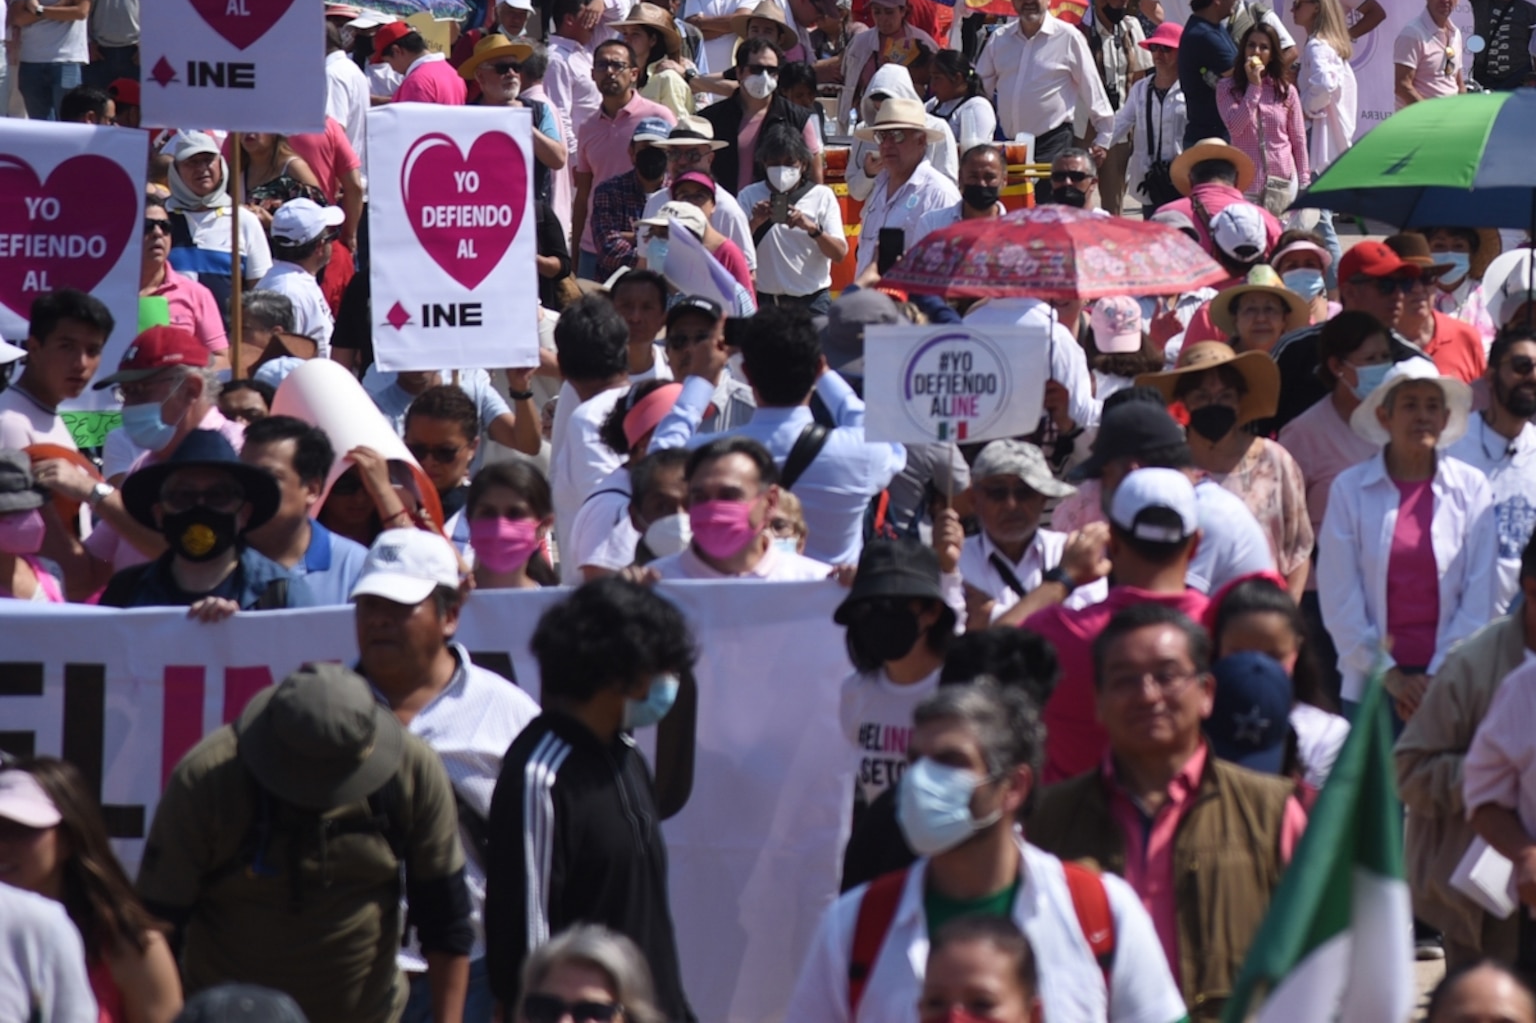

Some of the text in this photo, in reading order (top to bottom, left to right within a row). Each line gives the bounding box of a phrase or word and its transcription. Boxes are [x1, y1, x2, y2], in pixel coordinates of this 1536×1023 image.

[187, 60, 256, 89] INE
[453, 171, 480, 193] YO
[25, 196, 61, 220] YO
[421, 205, 513, 228] DEFIENDO
[457, 239, 478, 259] AL
[22, 270, 53, 292] AL
[422, 302, 483, 328] INE
[938, 351, 973, 373] #YO
[914, 373, 997, 395] DEFIENDO
[931, 395, 980, 417] ALINE
